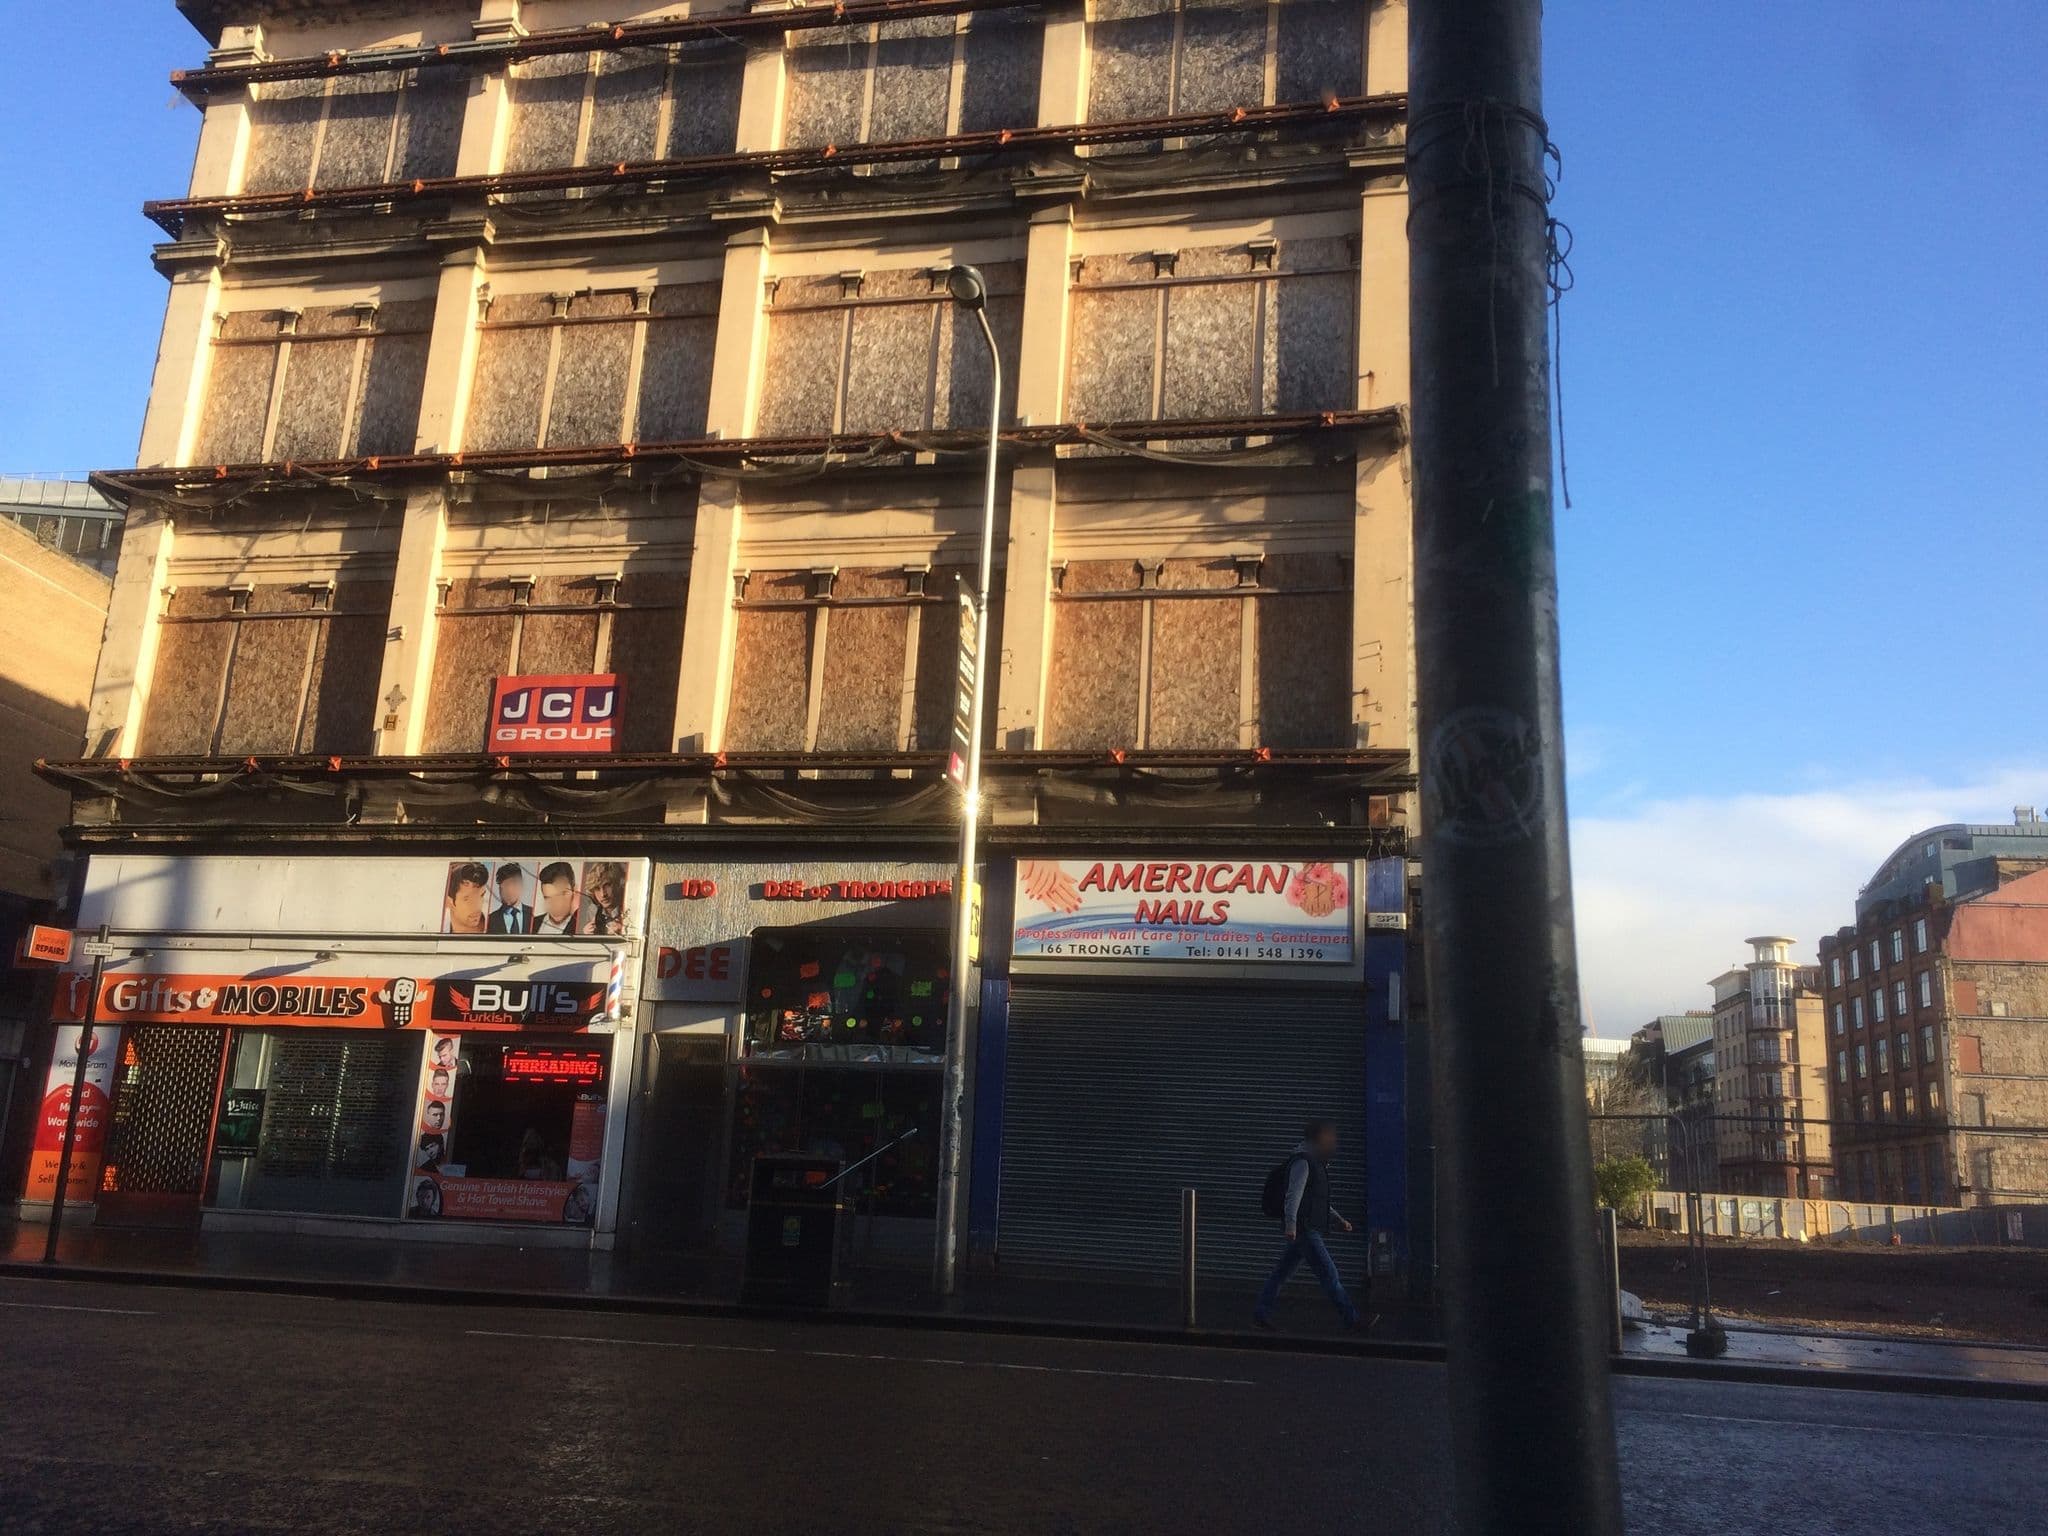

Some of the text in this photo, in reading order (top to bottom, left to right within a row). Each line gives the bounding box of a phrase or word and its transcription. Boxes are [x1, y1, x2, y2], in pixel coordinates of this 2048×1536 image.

[503, 690, 614, 718] JCJ
[496, 727, 616, 741] GROUP
[1078, 862, 1290, 894] AMERICAN
[763, 880, 805, 898] DEE
[1134, 898, 1230, 925] NAILS
[1016, 927, 1349, 944] Professional Nail Care for Ladies & Gentlemen
[35, 944, 65, 956] REPAIRS
[1040, 943, 1150, 956] 166 TRONGATE
[1186, 946, 1323, 959] Tel: 0141 548 1396
[657, 946, 730, 980] DEE
[113, 977, 368, 1017] Gifts & MOBILES
[472, 984, 578, 1013] Bull's
[461, 1012, 513, 1023] Turkish
[509, 1058, 598, 1075] THREADING
[44, 1159, 58, 1169] We
[38, 1174, 54, 1184] Sell
[440, 1181, 568, 1196] Genuine Turkish Hairstyles
[456, 1193, 546, 1207] & Hot Towel Shave
